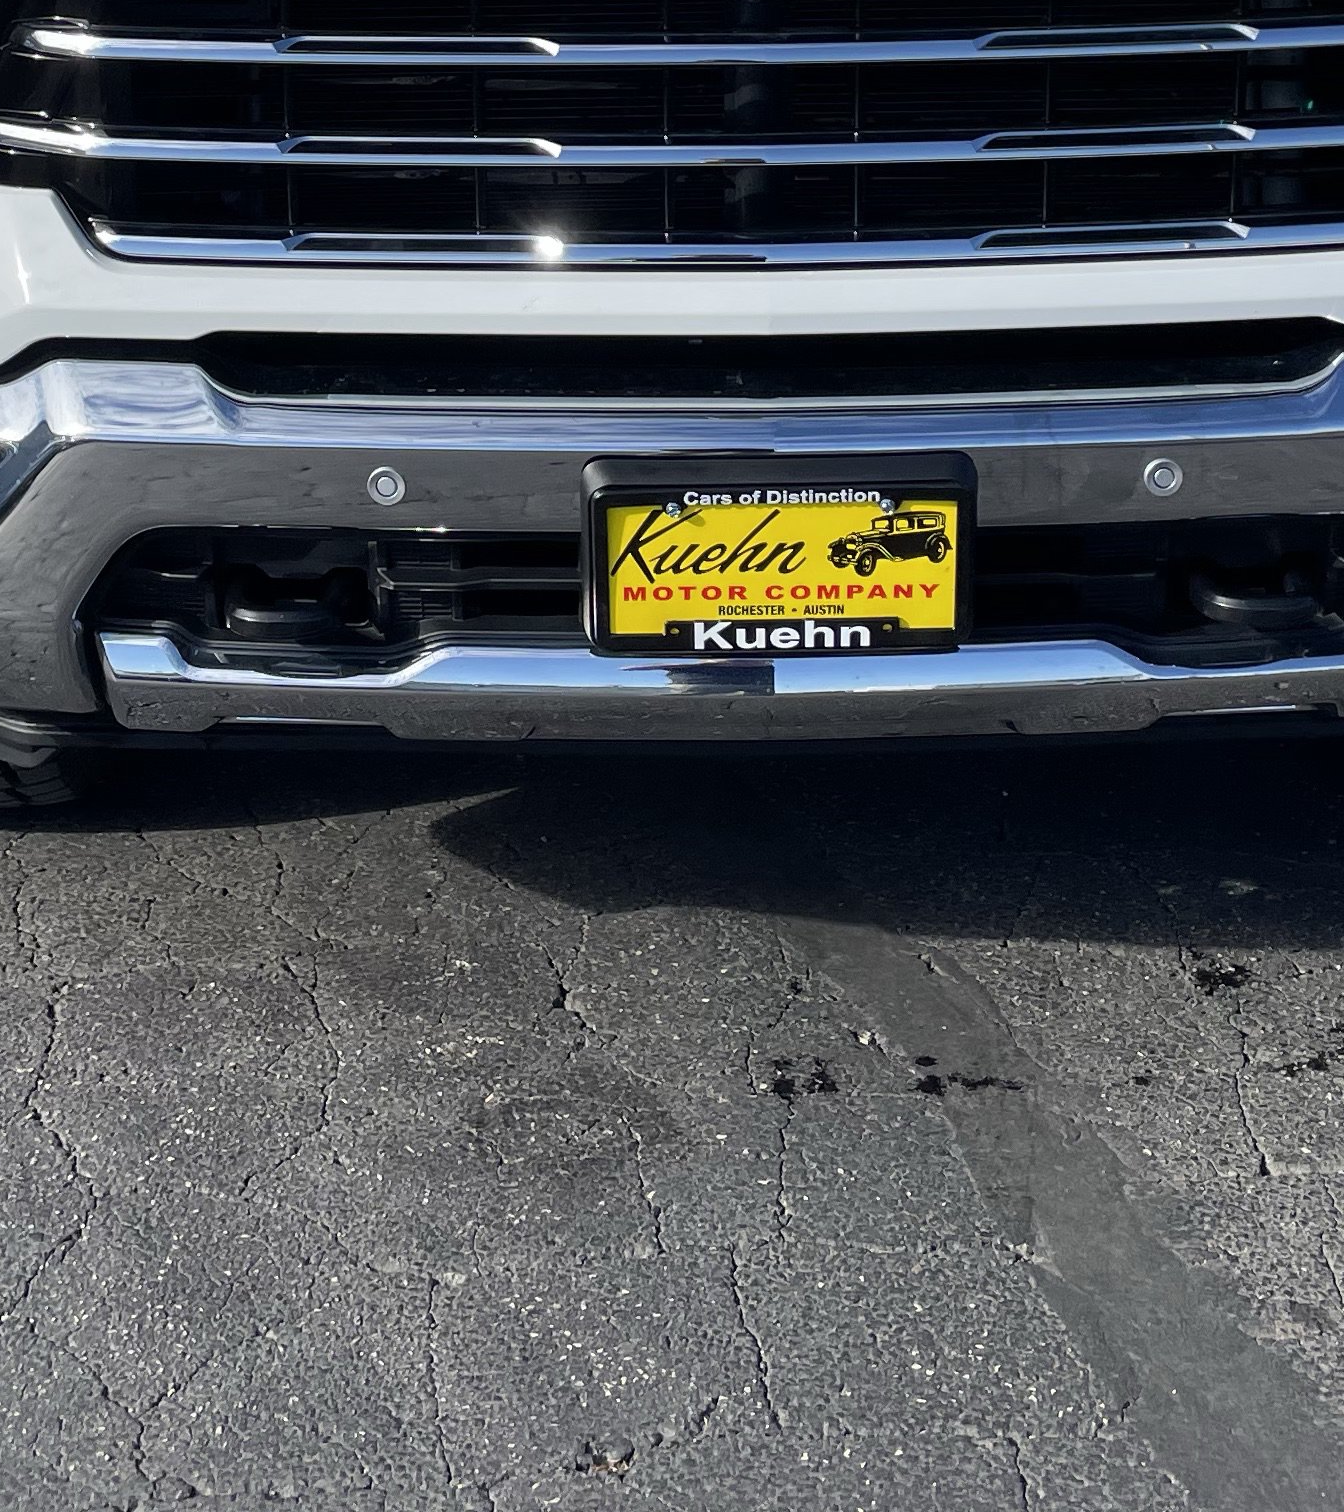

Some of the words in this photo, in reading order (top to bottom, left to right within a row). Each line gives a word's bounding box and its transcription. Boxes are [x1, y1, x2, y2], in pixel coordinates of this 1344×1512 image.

[683, 491, 735, 506] Cars
[738, 490, 762, 505] of
[766, 489, 881, 505] Distinction
[609, 508, 807, 584] Kuehn
[622, 585, 747, 602] MOTOR
[765, 583, 941, 600] COMPANY
[717, 604, 786, 616] ROCHESTER
[802, 603, 845, 616] AUSTIN
[693, 621, 872, 650] Kuehn
